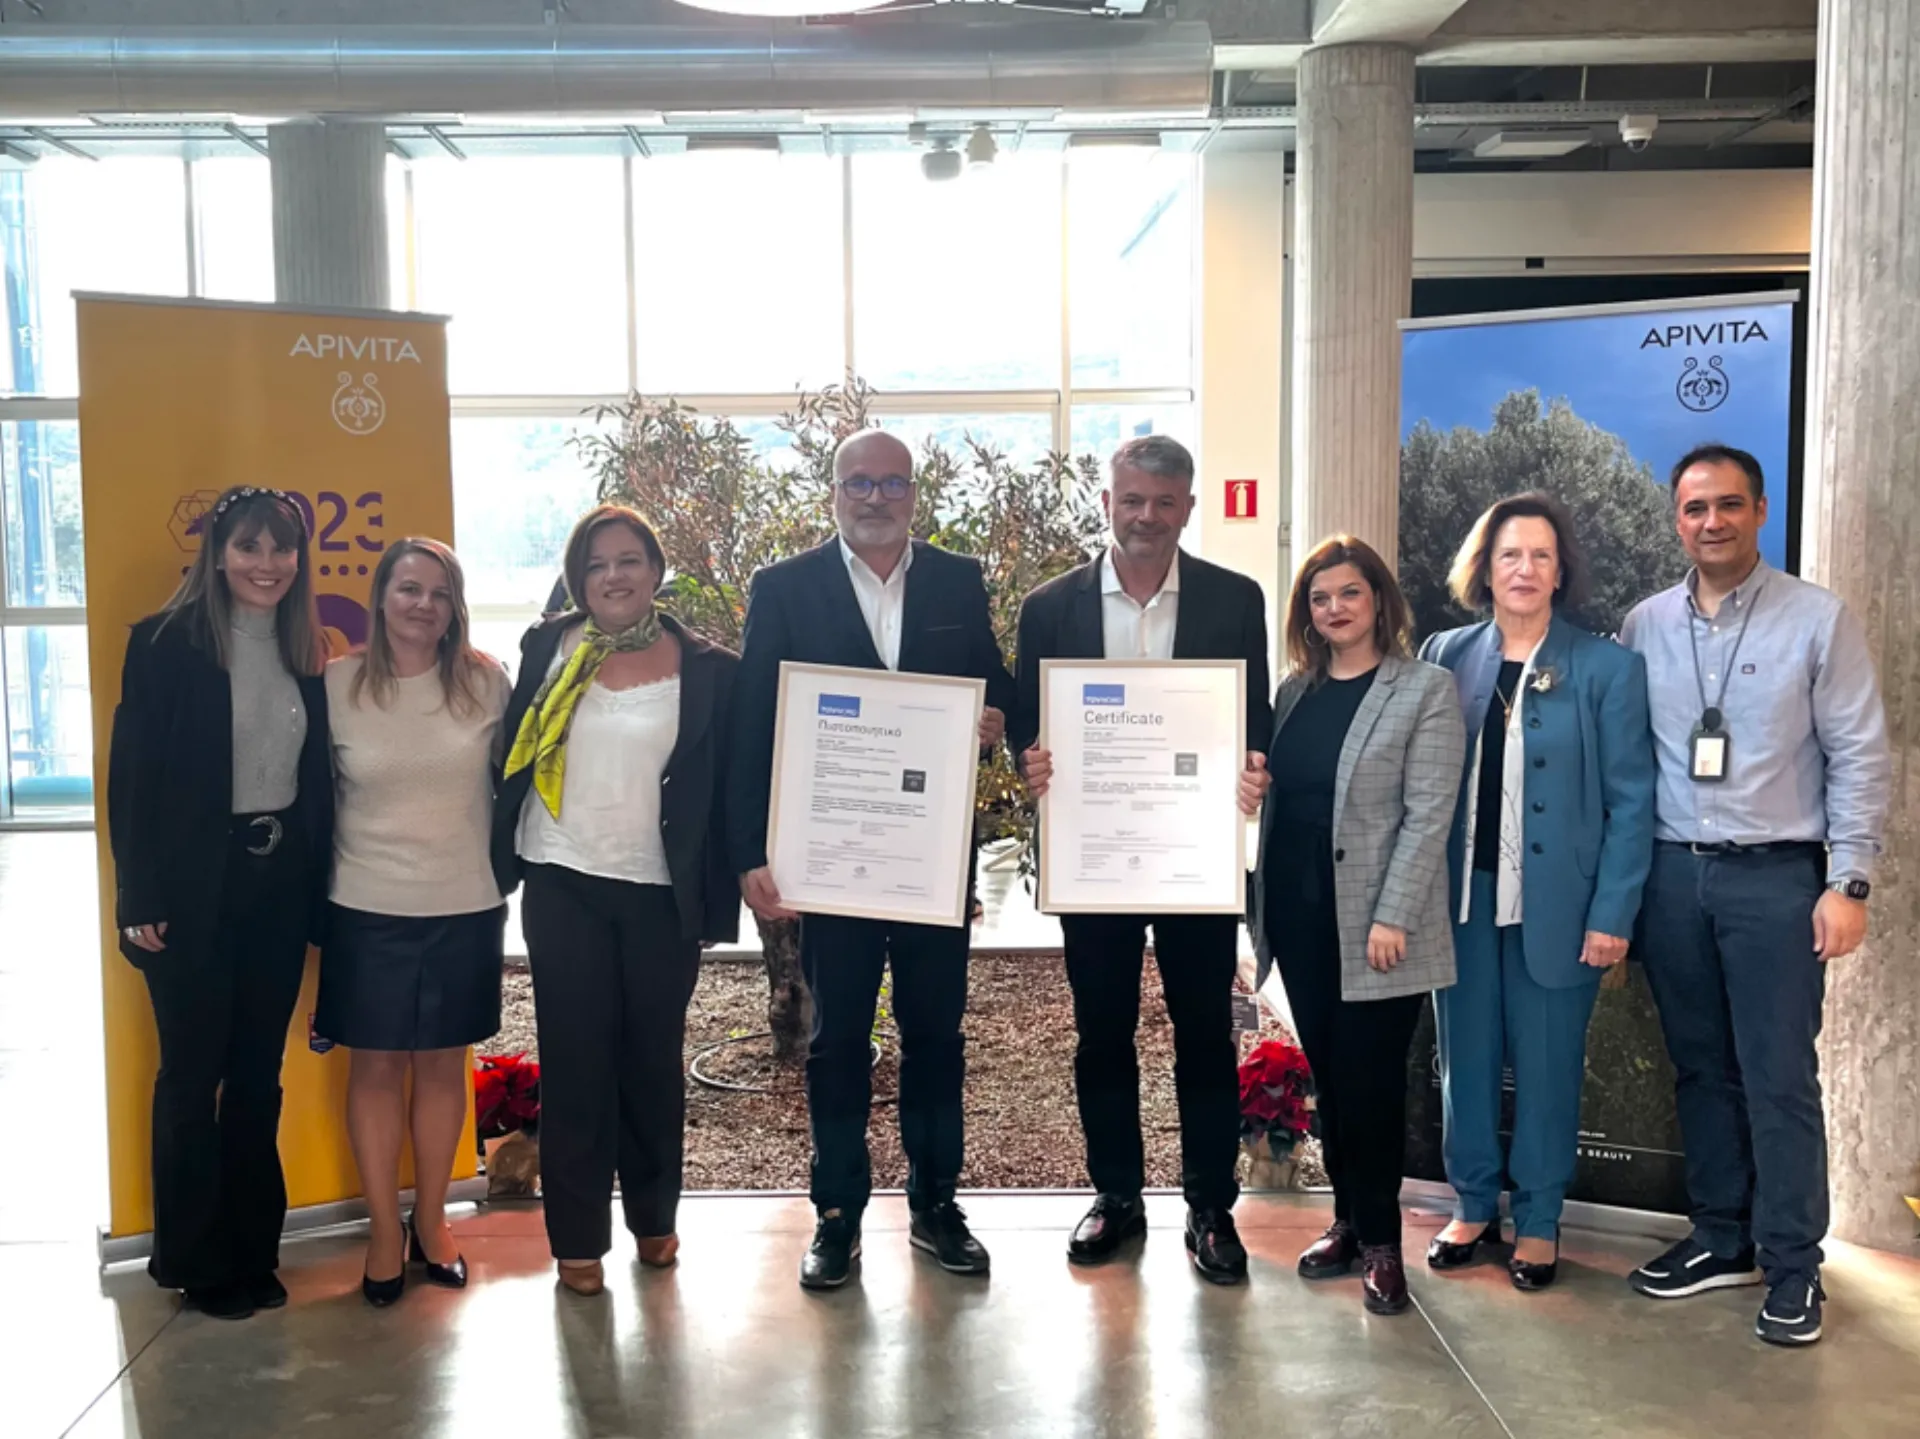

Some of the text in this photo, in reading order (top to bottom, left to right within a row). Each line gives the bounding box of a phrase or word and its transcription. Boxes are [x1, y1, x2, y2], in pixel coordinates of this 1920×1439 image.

[1639, 320, 1769, 350] APIVITA
[288, 333, 422, 363] APIVITA
[1083, 710, 1164, 726] Certificate
[1587, 1147, 1633, 1161] BEAUTY
